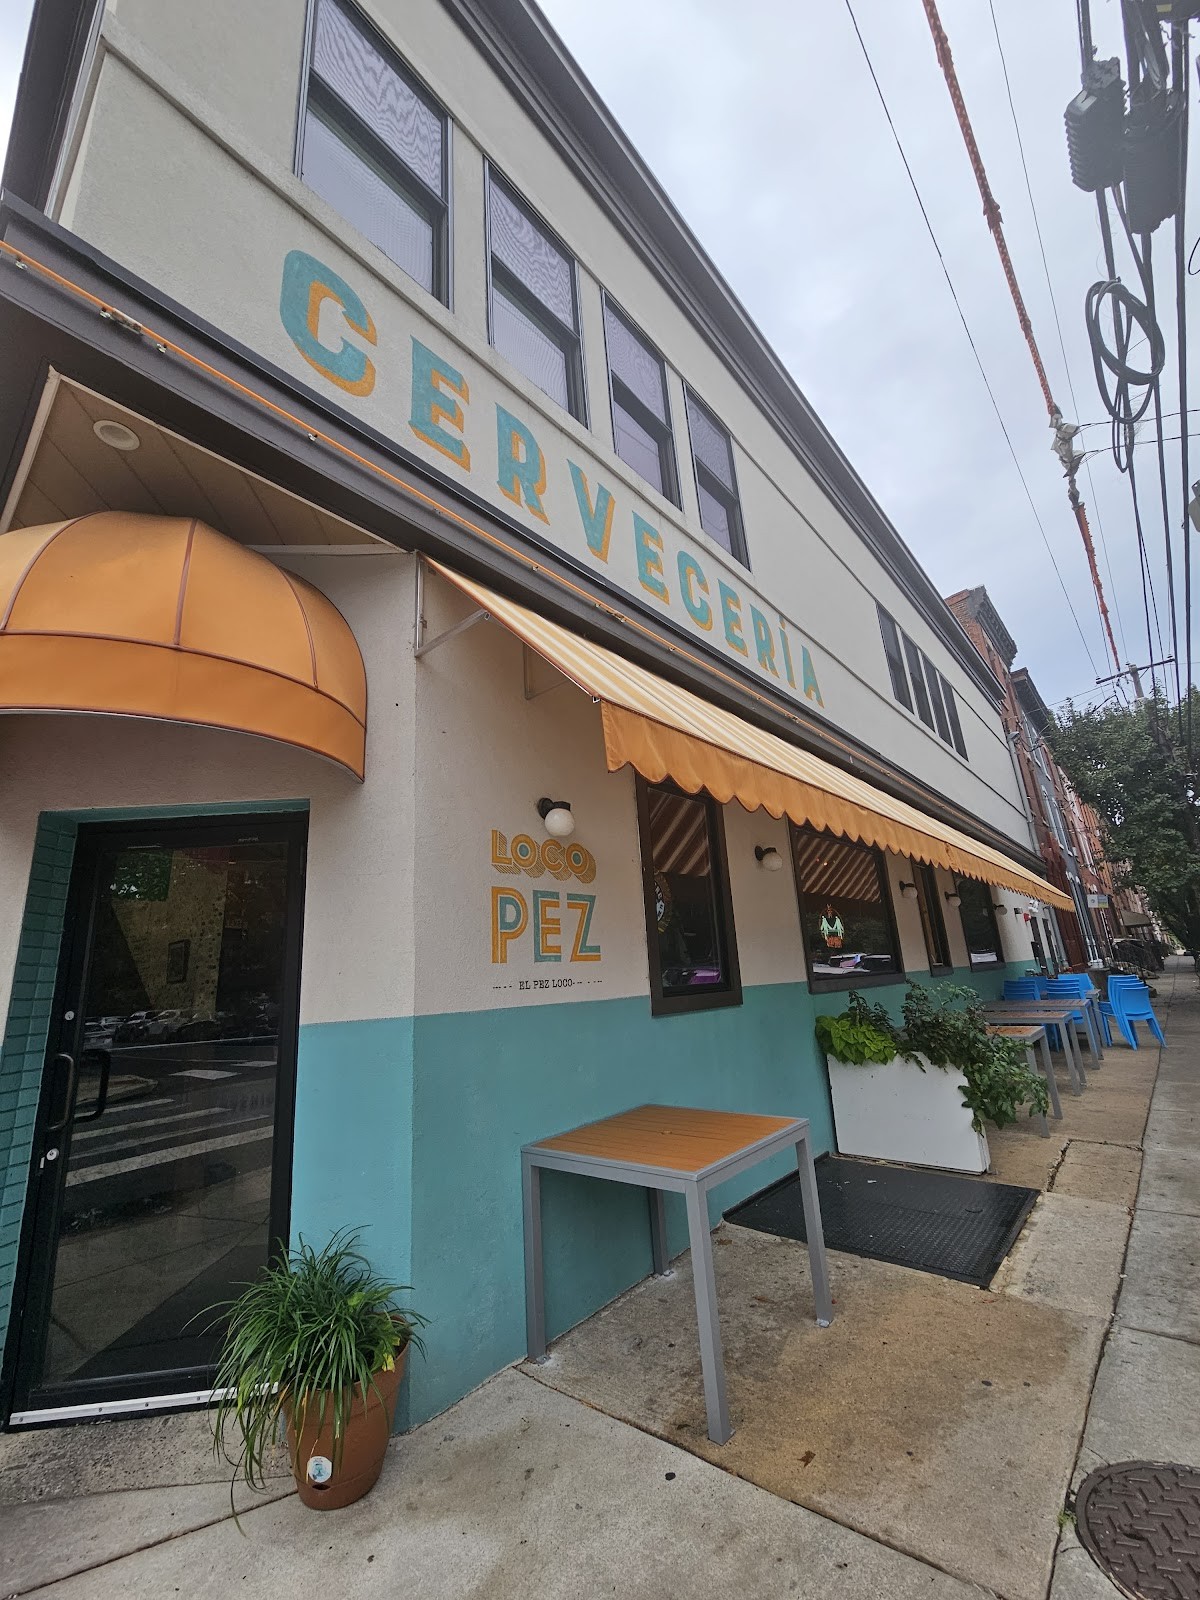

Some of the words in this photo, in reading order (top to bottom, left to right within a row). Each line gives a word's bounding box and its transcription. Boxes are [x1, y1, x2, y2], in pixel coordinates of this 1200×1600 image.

[491, 829, 596, 884] LOCO
[491, 886, 602, 964] PEZ
[519, 980, 531, 990] EL
[533, 979, 550, 989] PEZ
